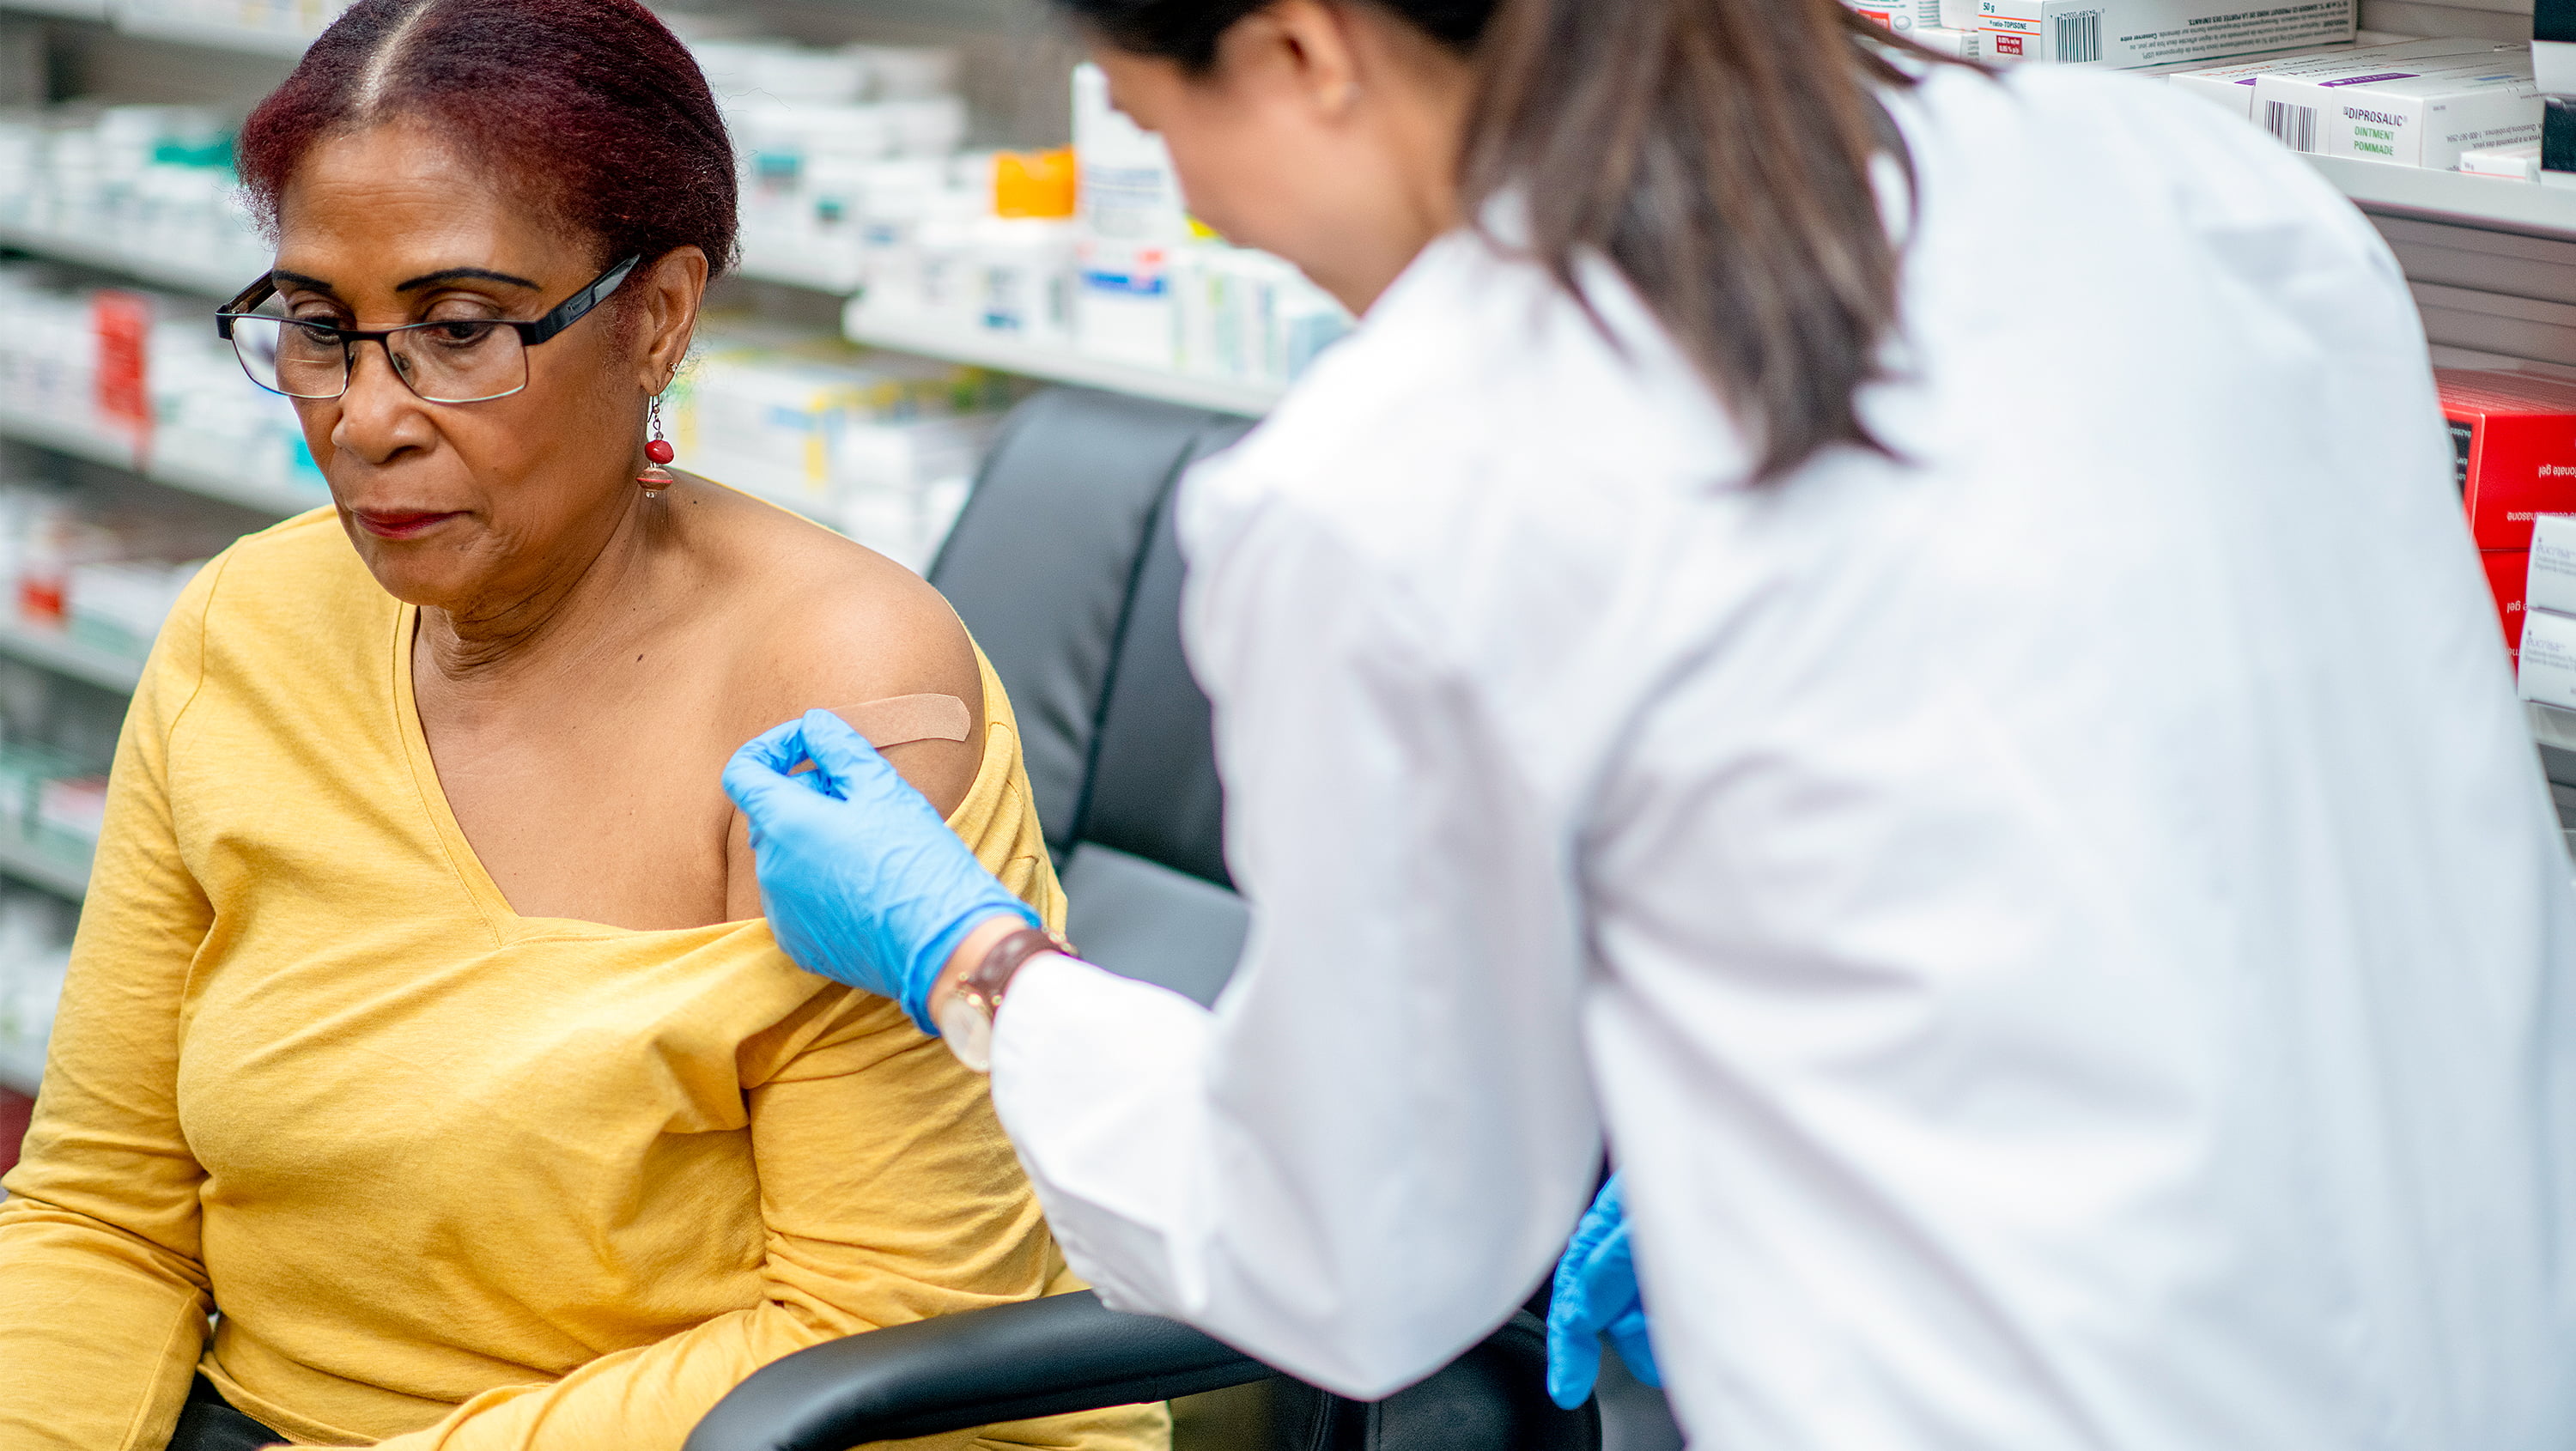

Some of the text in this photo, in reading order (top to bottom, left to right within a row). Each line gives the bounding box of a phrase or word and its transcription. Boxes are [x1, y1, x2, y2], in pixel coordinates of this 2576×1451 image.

[2354, 125, 2394, 141] OINTMENT
[2354, 140, 2394, 156] POMMADE
[2538, 464, 2552, 478] gel
[2506, 601, 2520, 613] gel
